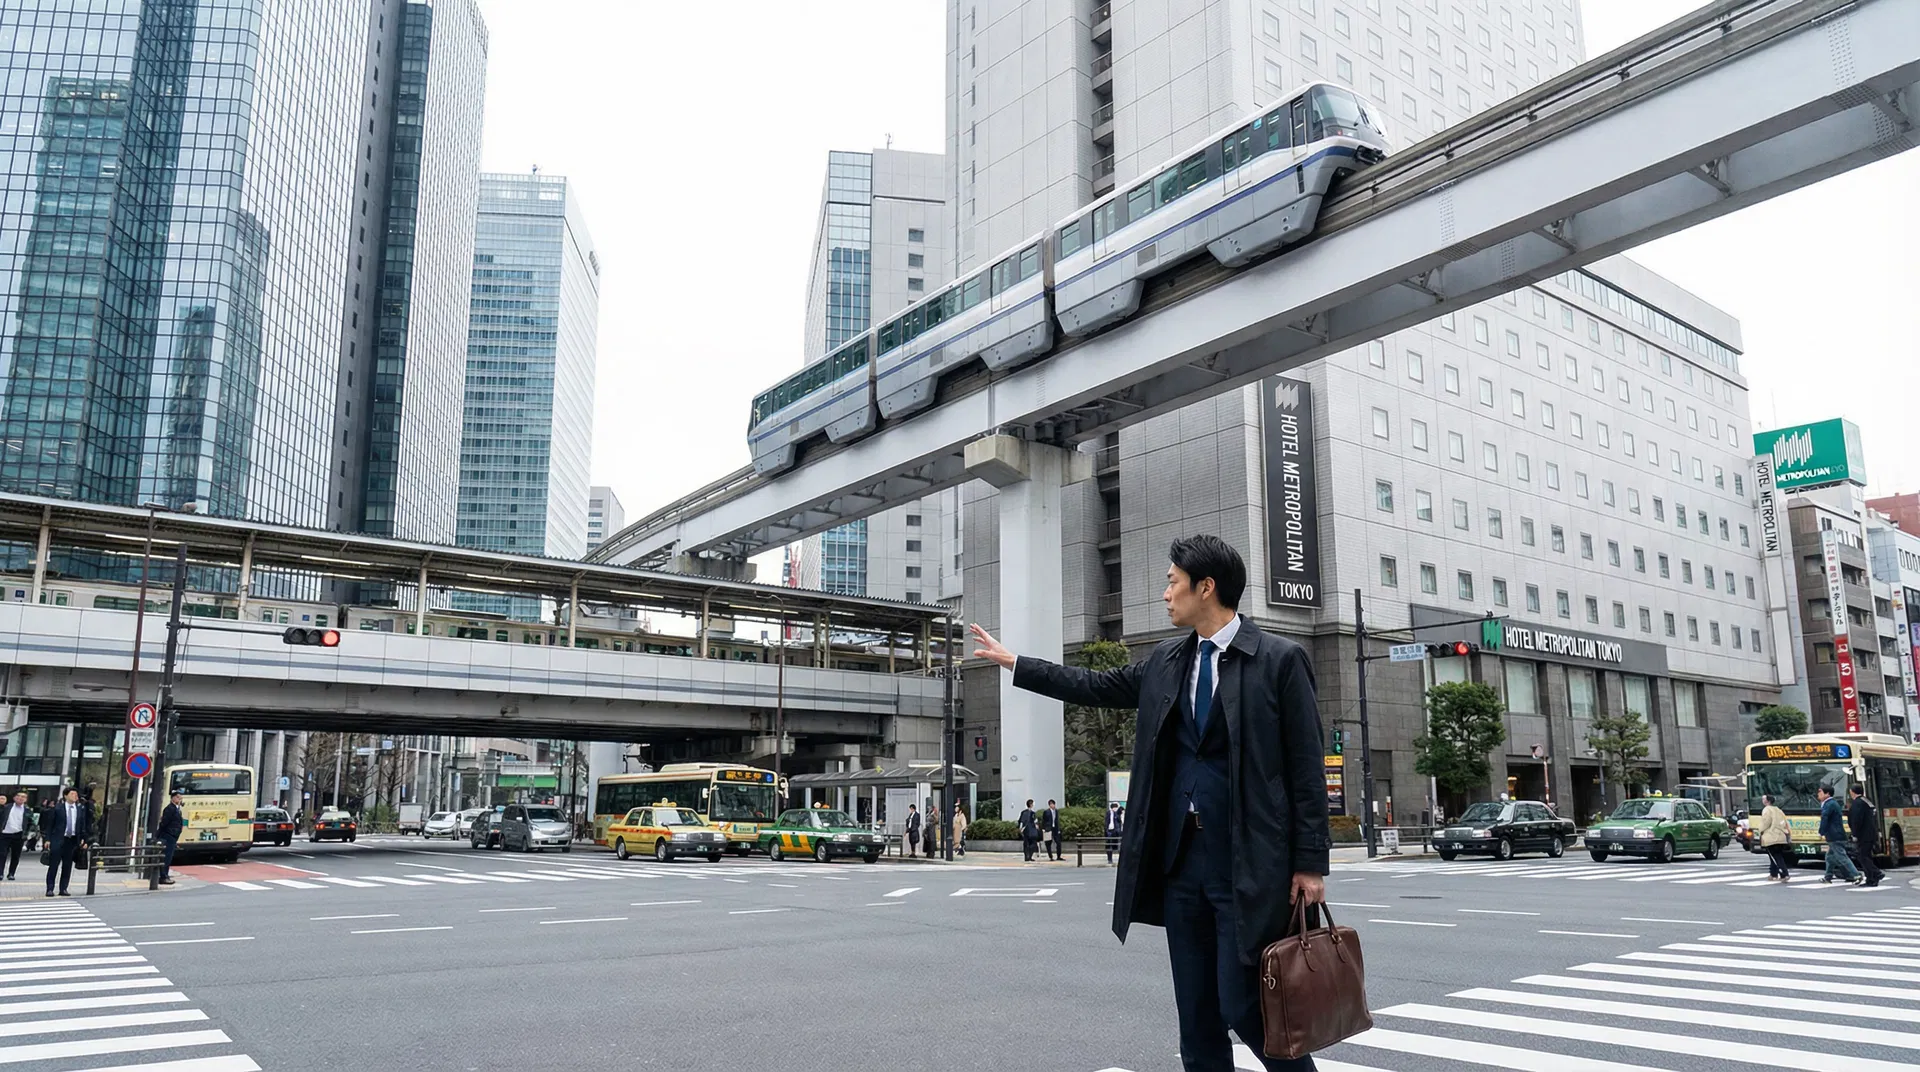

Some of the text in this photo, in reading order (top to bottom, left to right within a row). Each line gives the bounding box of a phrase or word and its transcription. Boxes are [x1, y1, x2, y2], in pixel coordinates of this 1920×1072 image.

[1757, 461, 1770, 487] HOTEL
[1281, 414, 1304, 572] HOTEL METROPOLITAN
[1278, 582, 1313, 600] TOKYO
[1505, 626, 1622, 663] HOTEL METROPOLITAN TOKYO
